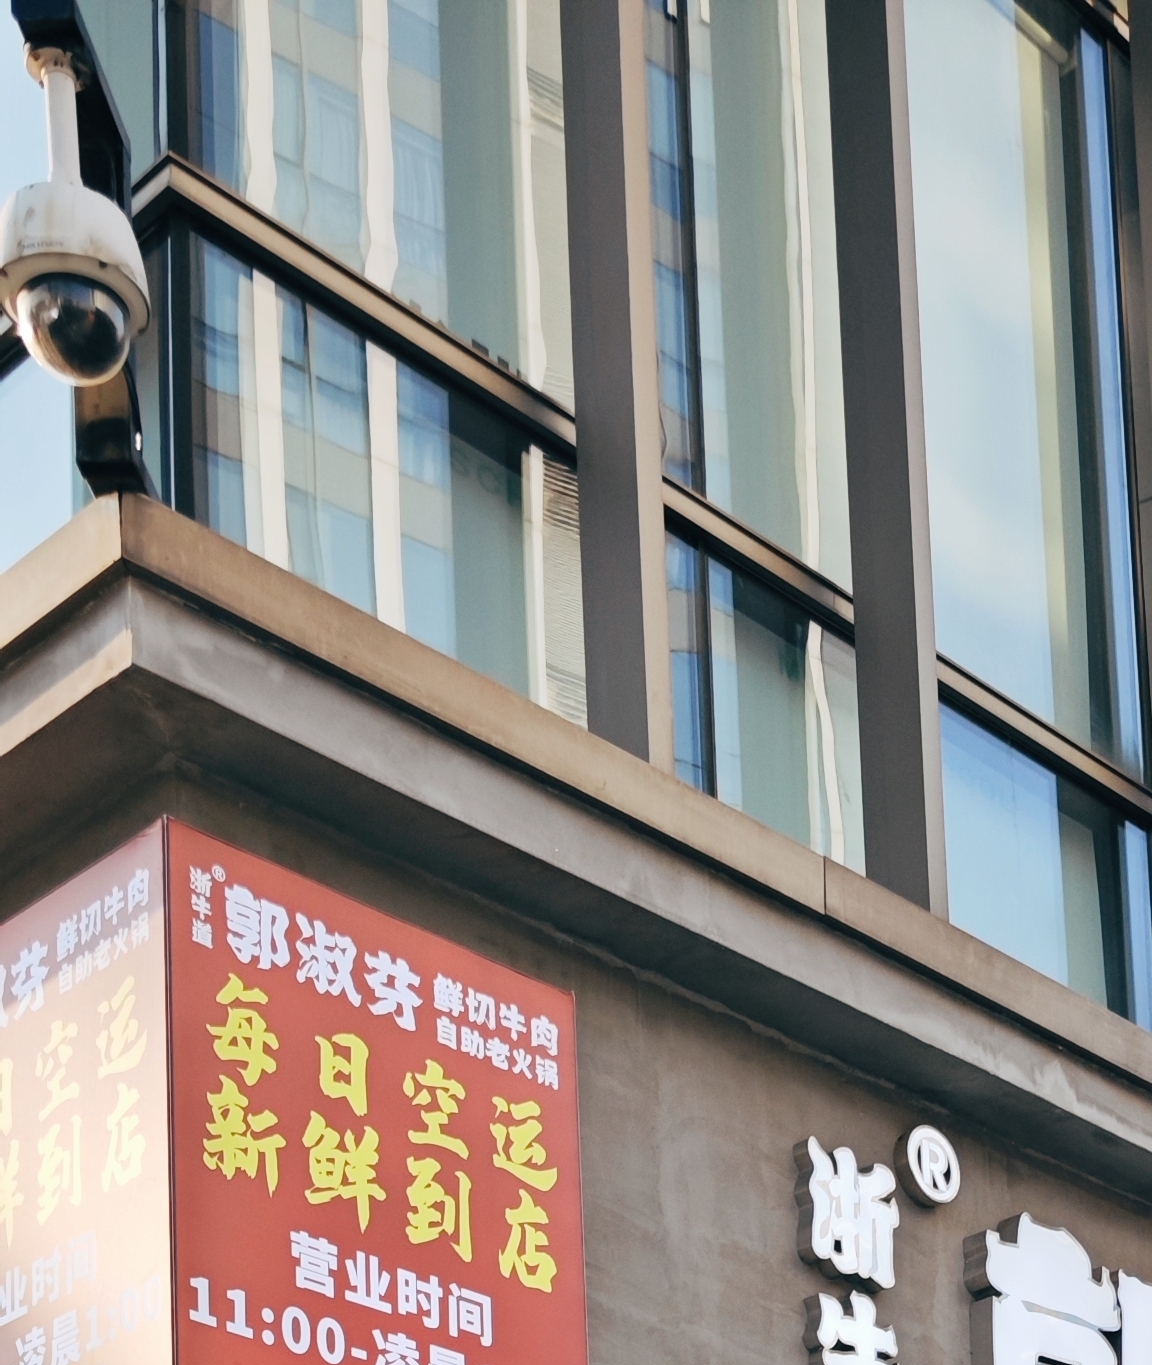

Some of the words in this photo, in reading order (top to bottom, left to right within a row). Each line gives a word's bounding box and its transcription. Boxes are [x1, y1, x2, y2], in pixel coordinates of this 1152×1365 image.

[56, 868, 150, 962] 鲜切牛肉
[58, 912, 150, 995] 自助老火锅
[189, 865, 213, 949] 浙牛道
[224, 884, 424, 1032] 郭淑芬
[432, 972, 558, 1057] 鲜切牛肉
[436, 1016, 560, 1091] 自助老火锅
[205, 973, 558, 1192] 每日空运
[202, 1076, 558, 1293] 新鲜到店
[289, 1230, 493, 1347] 营业时间
